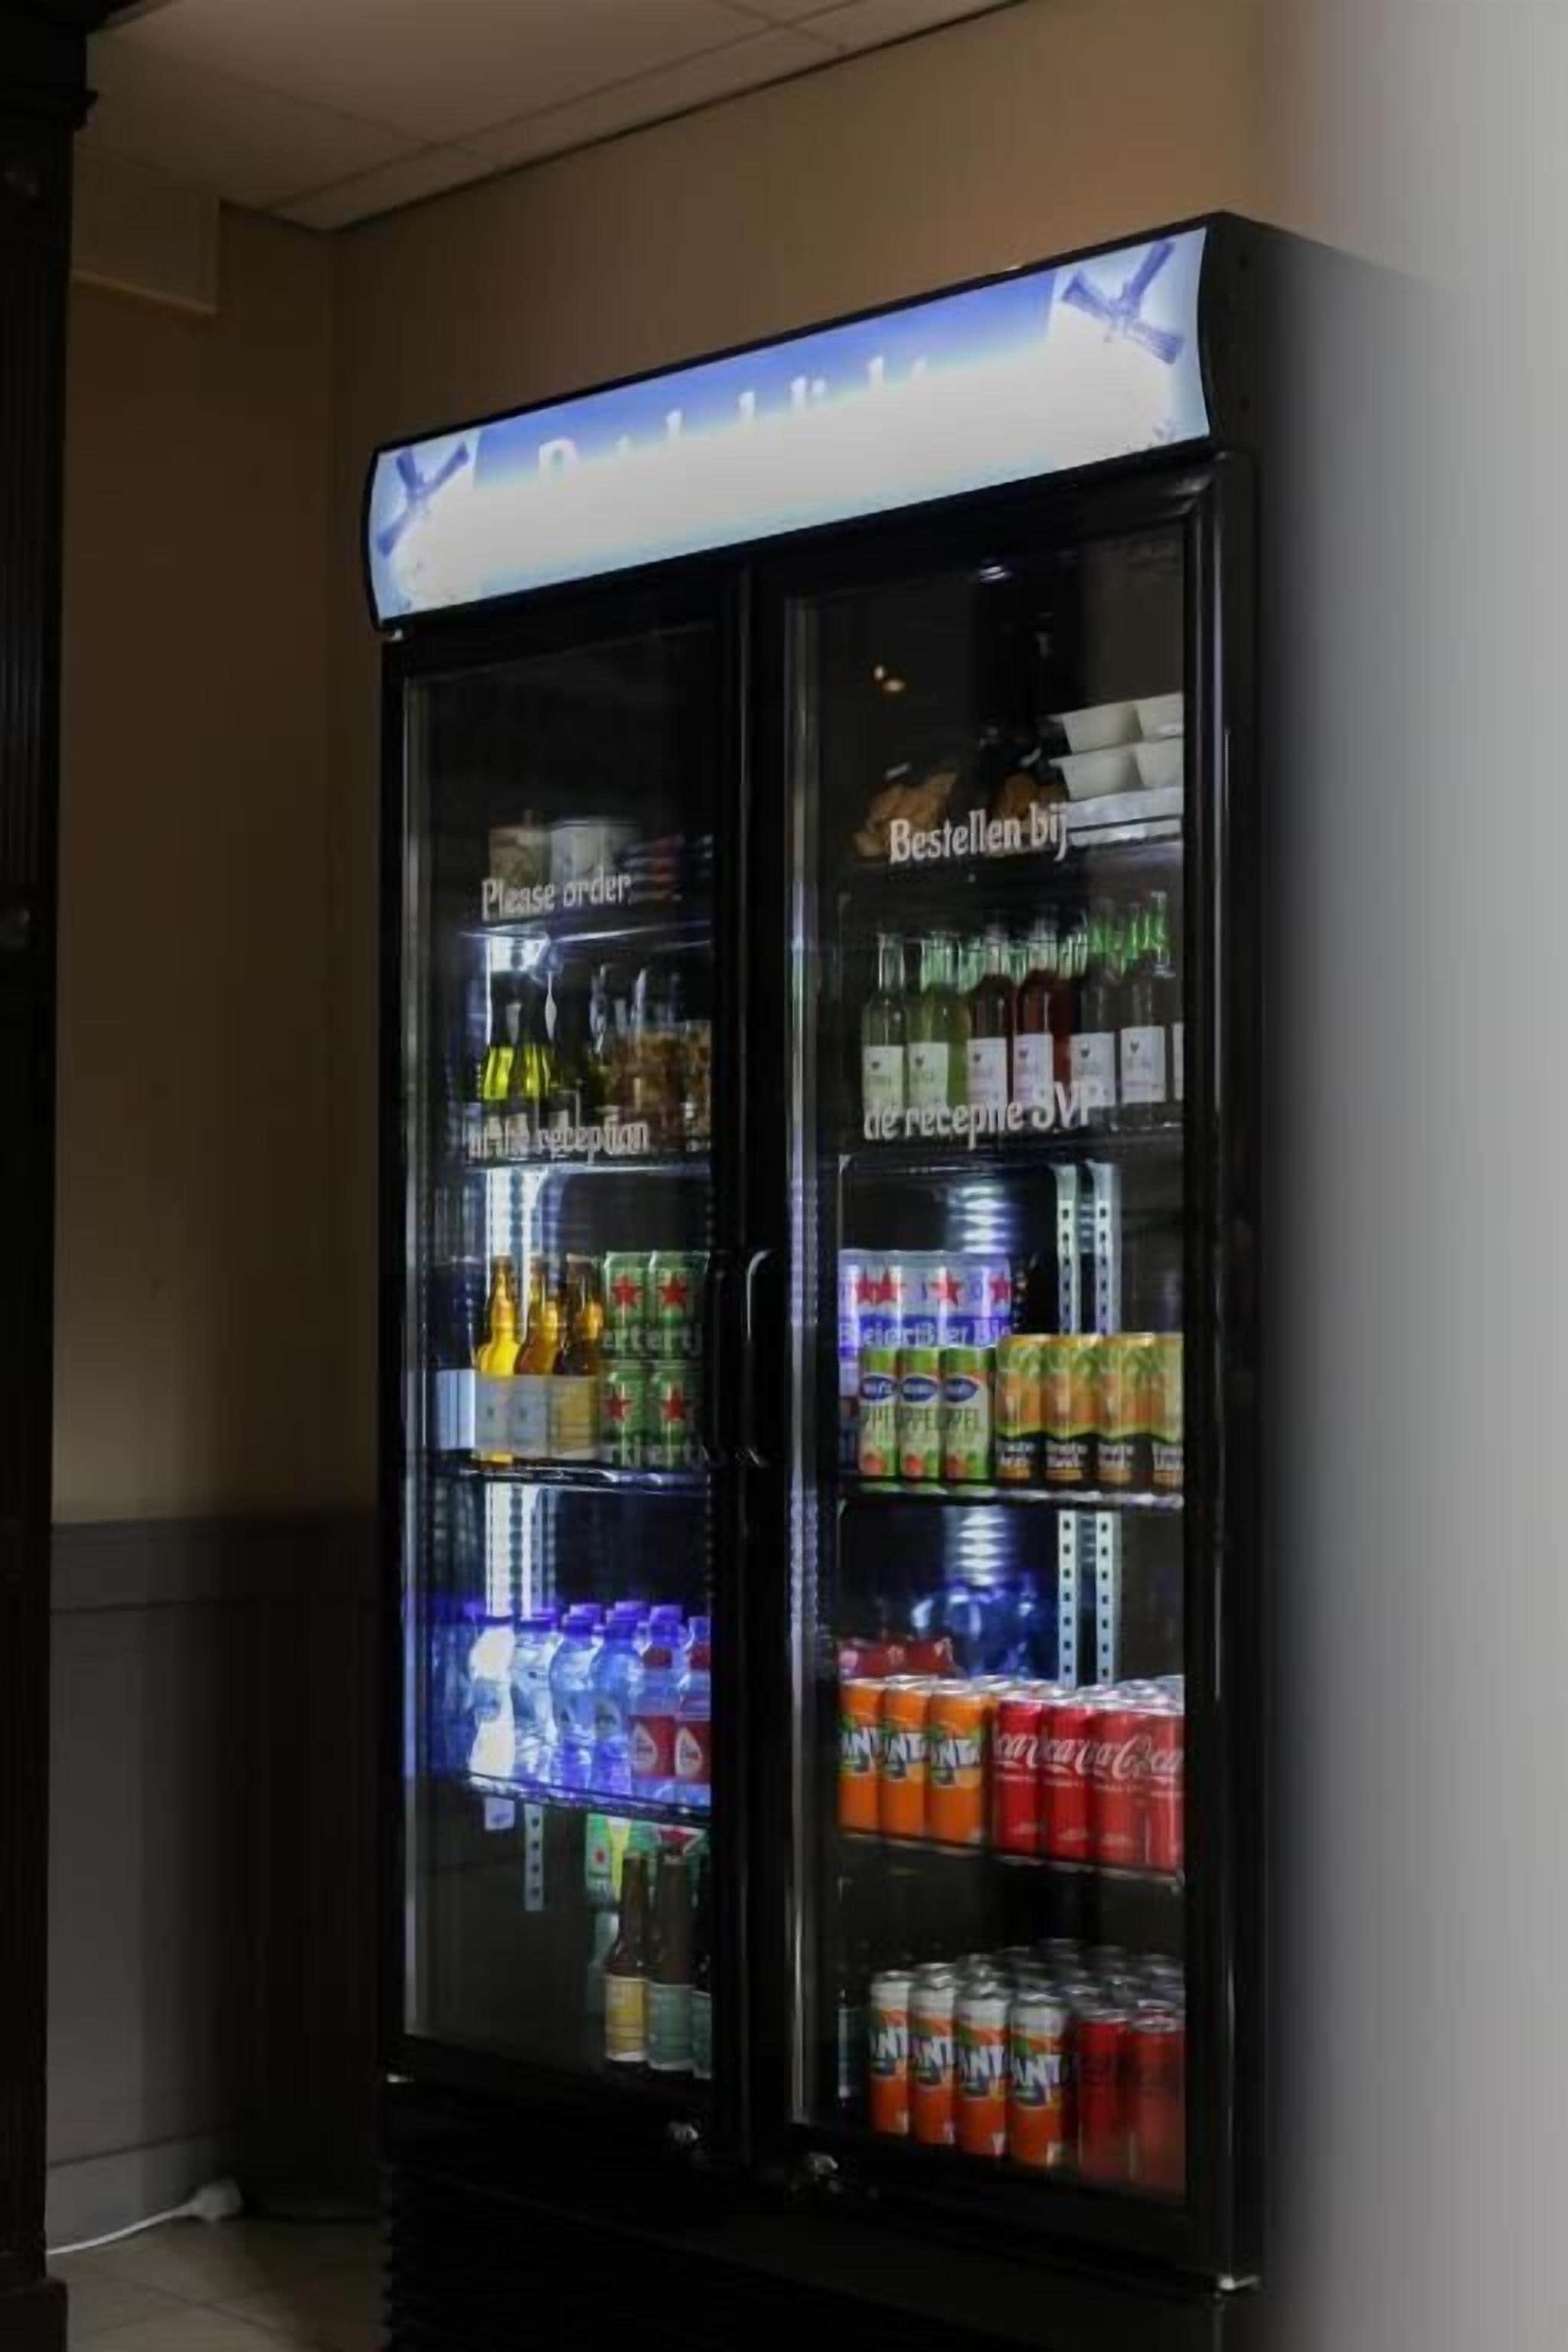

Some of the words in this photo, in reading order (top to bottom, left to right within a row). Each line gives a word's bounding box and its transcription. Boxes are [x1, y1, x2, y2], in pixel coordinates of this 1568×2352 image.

[890, 808, 1023, 864] Bestellen
[1030, 801, 1070, 862] bij
[482, 877, 555, 921] Please
[563, 866, 632, 909] order
[537, 1114, 649, 1164] reception
